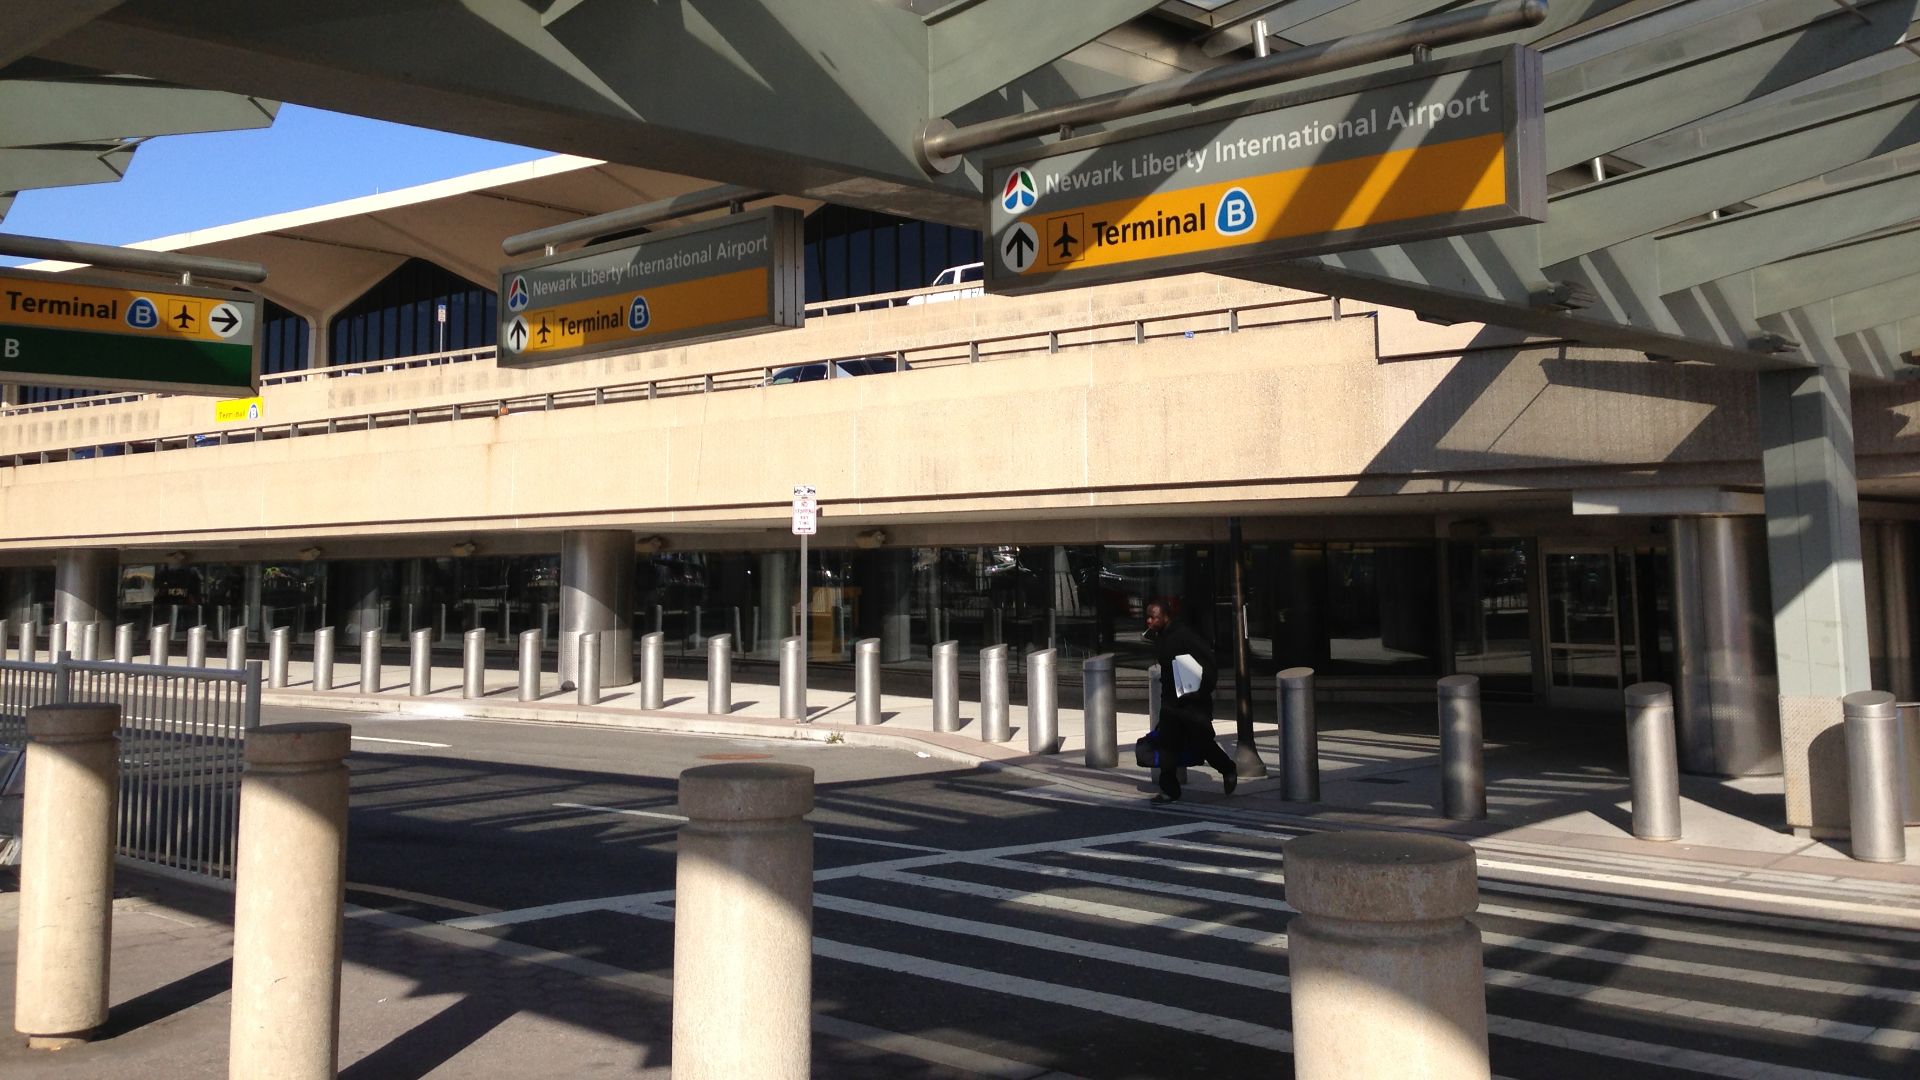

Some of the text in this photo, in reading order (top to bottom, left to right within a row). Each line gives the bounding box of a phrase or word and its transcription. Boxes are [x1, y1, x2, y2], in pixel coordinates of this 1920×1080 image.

[1046, 89, 1490, 194] Newark Liberty International Airport
[1092, 199, 1246, 247] Terminal B
[532, 233, 768, 297] Newark Liberty International Airport
[6, 291, 151, 324] Terminal B
[559, 304, 646, 337] Terminal B
[4, 338, 20, 358] B
